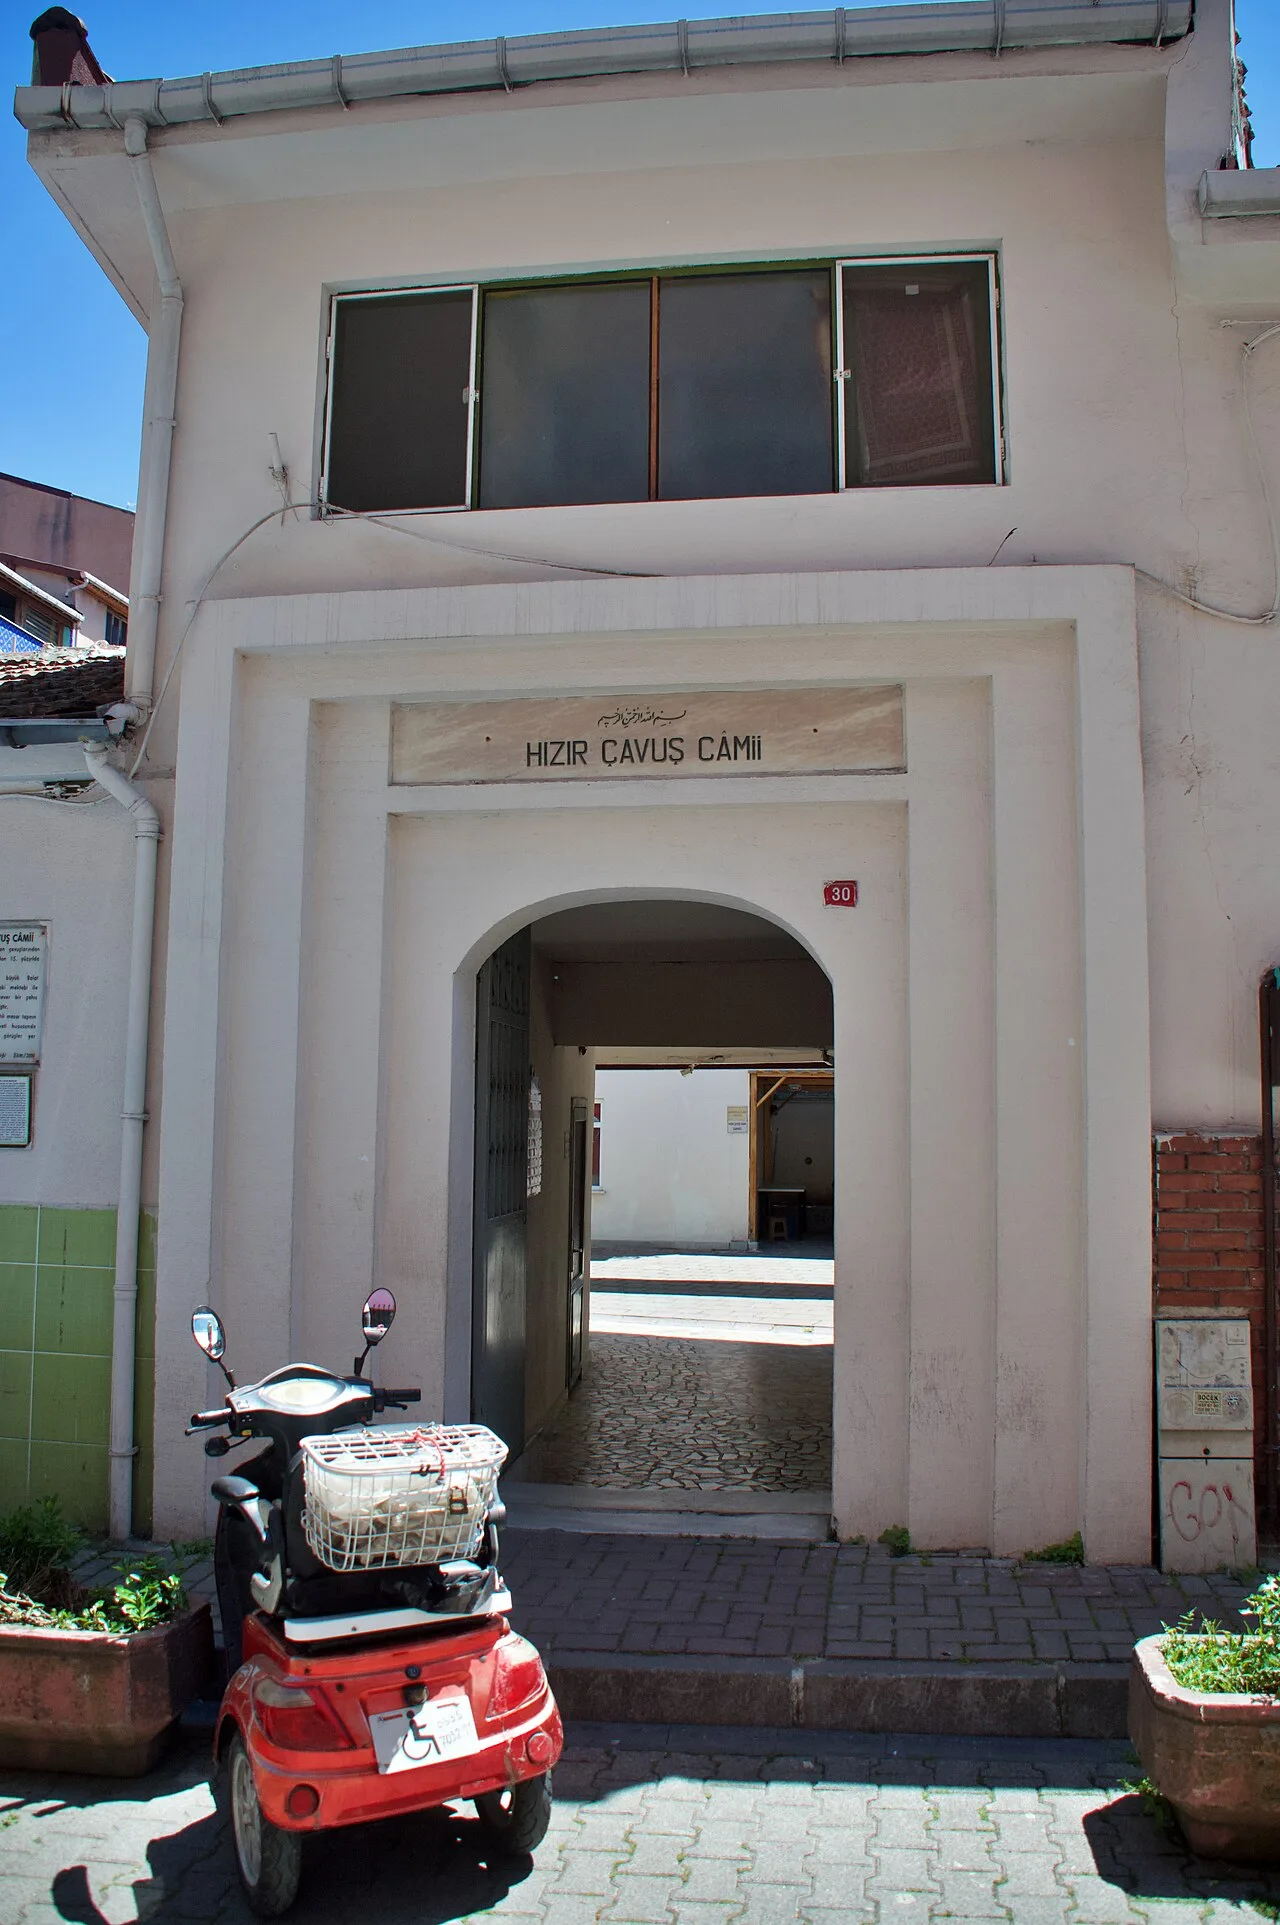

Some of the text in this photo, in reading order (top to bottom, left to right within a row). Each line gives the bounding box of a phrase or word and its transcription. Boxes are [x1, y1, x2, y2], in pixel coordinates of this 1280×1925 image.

[526, 740, 588, 767] HIZIR
[601, 737, 684, 767] ÇAVUŞ
[831, 887, 850, 901] 30
